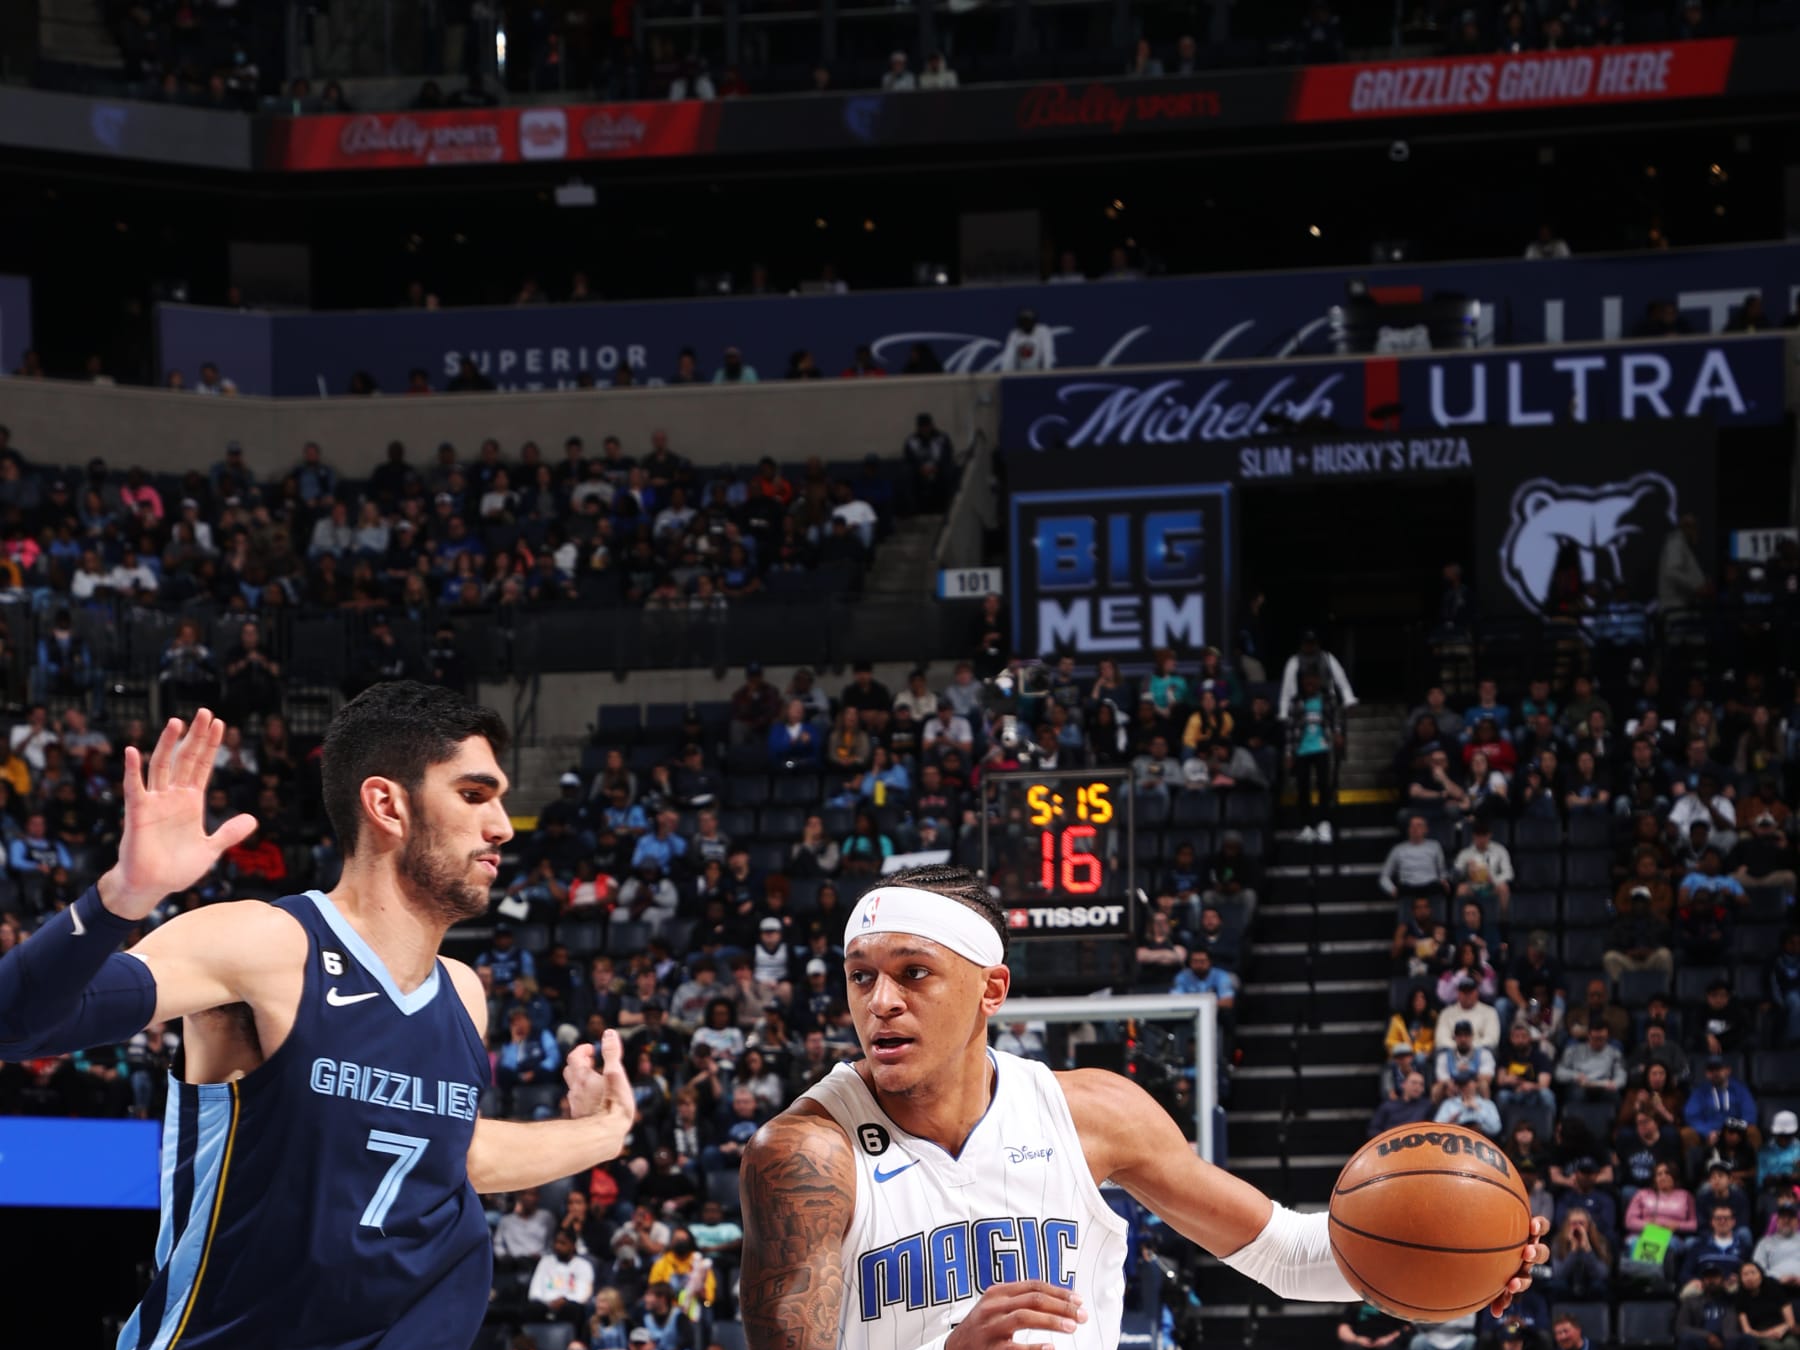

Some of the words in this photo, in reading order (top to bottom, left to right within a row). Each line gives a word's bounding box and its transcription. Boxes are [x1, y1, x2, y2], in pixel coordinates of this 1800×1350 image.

[1351, 64, 1496, 112] GRIZZLIES
[1497, 55, 1595, 102] GRIND
[1597, 48, 1675, 96] HERE
[443, 344, 648, 378] SUPERIOR
[1429, 347, 1747, 429] ULTRA
[1239, 444, 1294, 479] SLIM
[1311, 438, 1405, 476] HUSKY'S
[1408, 436, 1474, 472] PIZZA
[1035, 510, 1206, 590] BIG
[957, 573, 991, 592] 101
[1026, 780, 1114, 827] 5:15
[1040, 823, 1104, 894] 16
[1029, 905, 1125, 928] TISSOT
[321, 950, 344, 976] 6
[309, 1057, 479, 1121] GRIZZLIES
[860, 1128, 884, 1153] 6
[359, 1128, 431, 1228] 7
[858, 1216, 1079, 1323] MAGIC
